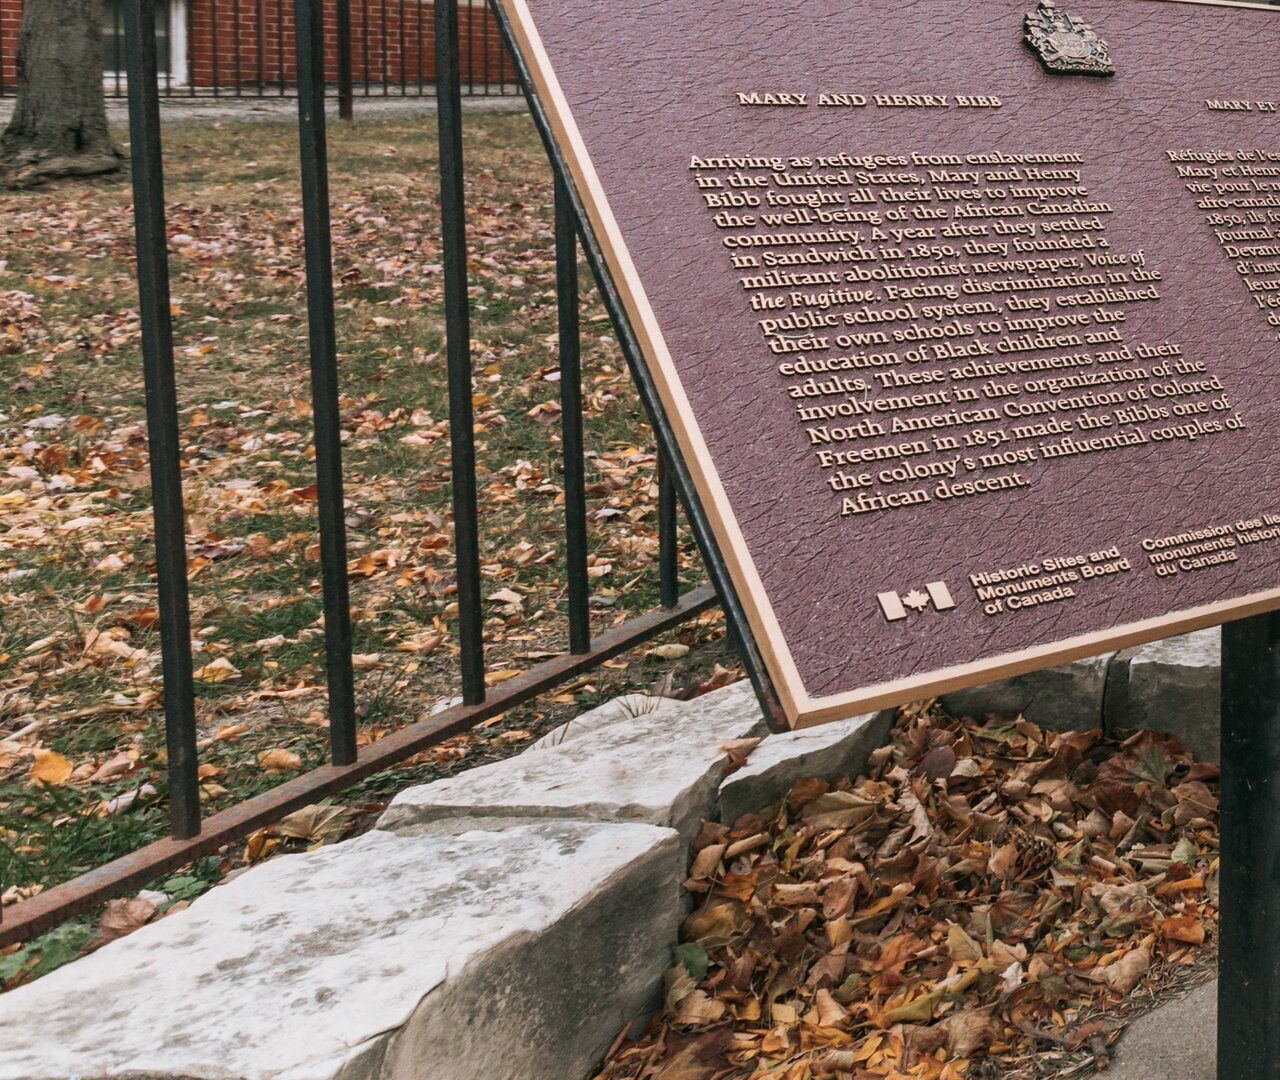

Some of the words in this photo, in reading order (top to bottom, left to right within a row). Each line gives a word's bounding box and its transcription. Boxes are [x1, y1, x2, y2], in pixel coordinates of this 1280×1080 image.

[737, 91, 806, 105] MARY
[818, 92, 867, 105] AND
[874, 93, 947, 106] HENRY
[955, 94, 1001, 106] BIBB
[1205, 98, 1252, 110] MARY
[1255, 100, 1276, 111] ET
[690, 153, 785, 170] Arriving
[788, 155, 813, 167] as
[817, 151, 907, 169] refugees
[910, 150, 961, 165] from
[966, 150, 1083, 164] enslavement
[1166, 148, 1233, 163] Réfugiés
[1235, 148, 1256, 161] de
[695, 172, 722, 187] in
[727, 171, 767, 187] the
[773, 169, 852, 185] United
[855, 170, 926, 184] States,
[928, 169, 979, 184] Mary
[984, 165, 1022, 181] and
[1024, 167, 1080, 181] Henry
[703, 190, 760, 207] Bibb
[766, 188, 843, 207] fought
[848, 186, 876, 202] all
[880, 186, 931, 201] their
[933, 185, 982, 200] lives
[984, 187, 1007, 198] to
[1009, 184, 1087, 200] improve
[713, 210, 755, 227] the
[762, 207, 882, 224] well-being
[884, 204, 908, 220] of
[911, 203, 947, 219] the
[954, 202, 1023, 217] African
[1026, 198, 1112, 214] Canadian
[1205, 212, 1247, 227] 1850,
[1245, 209, 1266, 223] ils
[723, 228, 865, 246] community.
[871, 226, 887, 240] A
[890, 226, 935, 242] year
[940, 221, 988, 236] after
[992, 219, 1036, 236] they
[1040, 215, 1103, 231] settled
[1214, 225, 1273, 242] journal
[730, 251, 759, 267] in
[762, 245, 875, 265] Sandwich
[878, 244, 905, 259] in
[908, 242, 961, 259] 1850,
[963, 239, 1008, 256] they
[1012, 233, 1094, 251] founded
[1096, 236, 1109, 247] a
[741, 269, 838, 288] militant
[845, 261, 967, 281] abolitionist
[973, 256, 1084, 273] newspaper,
[1084, 251, 1127, 265] Voice
[1130, 248, 1145, 266] of
[760, 310, 837, 335] public
[842, 302, 917, 323] school
[921, 301, 1003, 320] system,
[1005, 294, 1050, 311] they
[1056, 284, 1159, 305] established
[779, 351, 899, 374] education
[904, 343, 929, 362] of
[932, 338, 992, 358] Black
[996, 332, 1081, 352] children
[1084, 325, 1122, 343] and
[798, 390, 948, 419] involvement
[952, 385, 979, 401] in
[982, 379, 1020, 397] the
[1024, 367, 1148, 393] organization
[1151, 359, 1173, 376] of
[1174, 357, 1206, 373] the
[807, 418, 884, 443] North
[892, 407, 999, 432] American
[1003, 391, 1123, 416] Convention
[1126, 382, 1148, 400] of
[1150, 374, 1222, 396] Colored
[828, 470, 872, 490] the
[878, 454, 975, 482] colony's
[979, 446, 1037, 467] most
[1039, 426, 1146, 457] influential
[1150, 418, 1222, 440] couples
[1225, 411, 1245, 429] of
[842, 489, 929, 514] African
[935, 472, 1030, 498] descent.
[1142, 524, 1232, 549] Commission
[1234, 518, 1262, 530] des
[1149, 537, 1235, 562] monuments
[1155, 562, 1177, 576] du
[1178, 549, 1237, 569] Canada
[970, 563, 1039, 585] Historic
[1042, 554, 1086, 571] Sites
[1088, 545, 1120, 561] and
[977, 570, 1077, 599] Monuments
[1080, 557, 1131, 577] Board
[983, 598, 1003, 614] of
[1006, 586, 1073, 608] Canada
